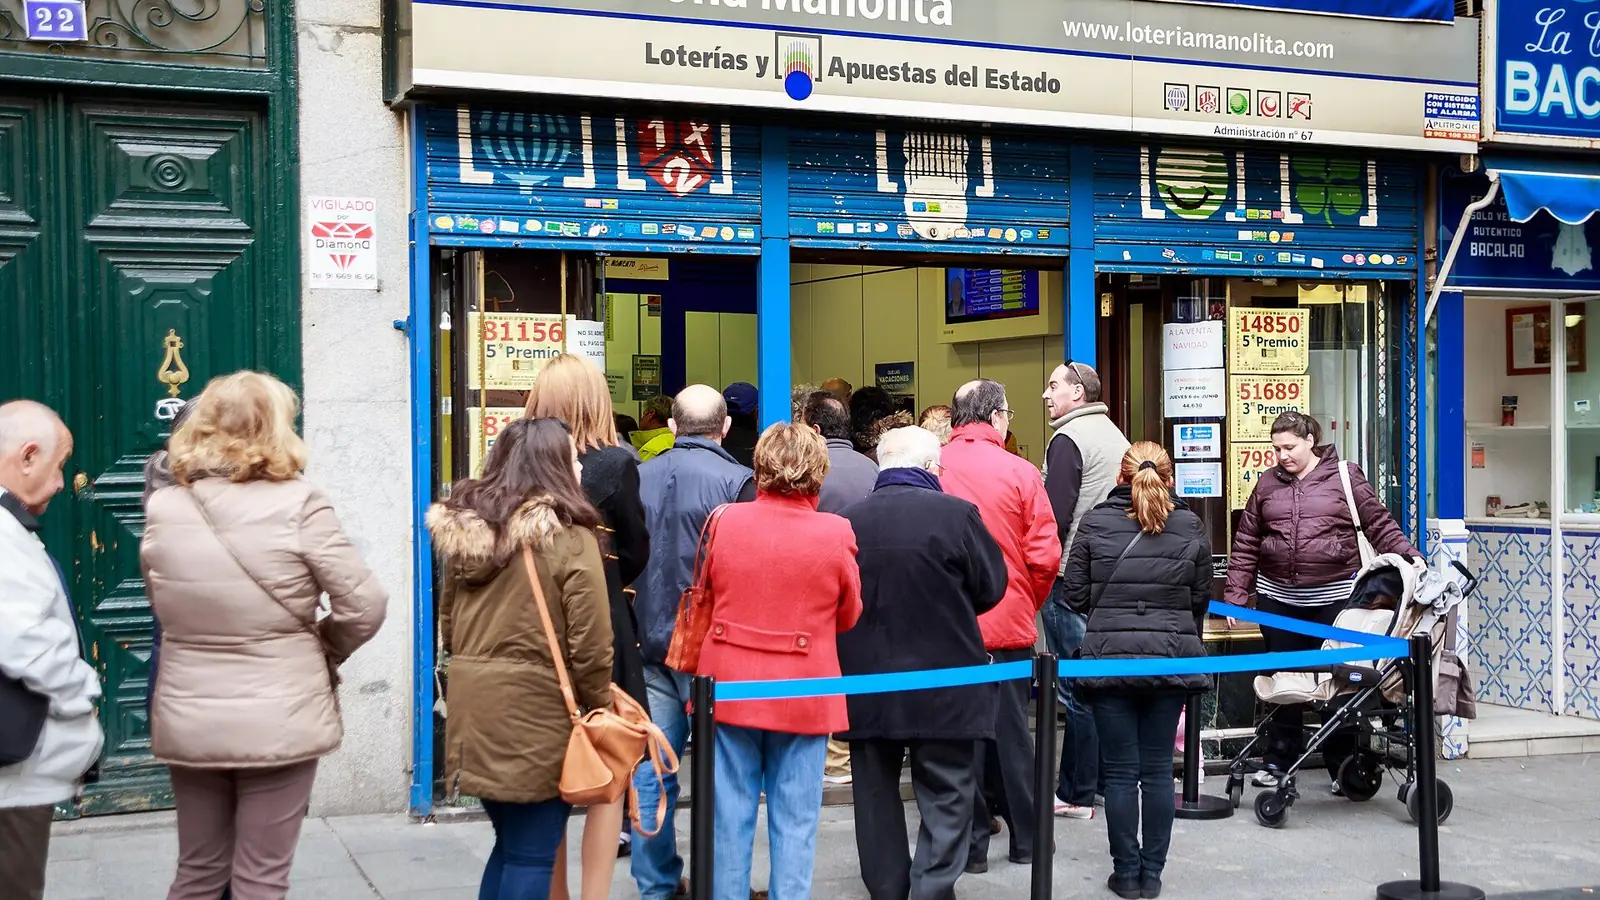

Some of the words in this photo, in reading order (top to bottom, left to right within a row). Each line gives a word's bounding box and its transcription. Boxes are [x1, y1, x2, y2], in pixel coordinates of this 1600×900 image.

[36, 8, 74, 31] 22
[1525, 8, 1572, 55] La
[1063, 20, 1334, 59] www.loteriamanolita.com
[645, 42, 748, 70] Loterías
[755, 55, 769, 78] y
[828, 56, 937, 84] Apuestas
[944, 64, 978, 87] del
[985, 68, 1061, 94] Estado
[1427, 94, 1476, 103] PROTEGIDO
[1444, 102, 1477, 110] SISTEMA
[1440, 109, 1477, 117] ALARMA
[1425, 119, 1478, 130] APLITRONIC
[1214, 126, 1286, 139] Administración
[1301, 131, 1313, 141] 67
[311, 199, 374, 211] VIGILADO
[1470, 211, 1493, 220] SOLO
[1473, 226, 1522, 237] AUTENTICO
[1470, 241, 1525, 258] BACALAO
[1240, 315, 1300, 333] 14850
[484, 321, 563, 342] 81156
[1172, 341, 1208, 350] NAVIDAD
[1256, 336, 1298, 348] Premio
[506, 346, 561, 359] Premio
[1240, 383, 1300, 400] 51689
[1257, 403, 1298, 414] Premio
[1240, 450, 1275, 468] 798
